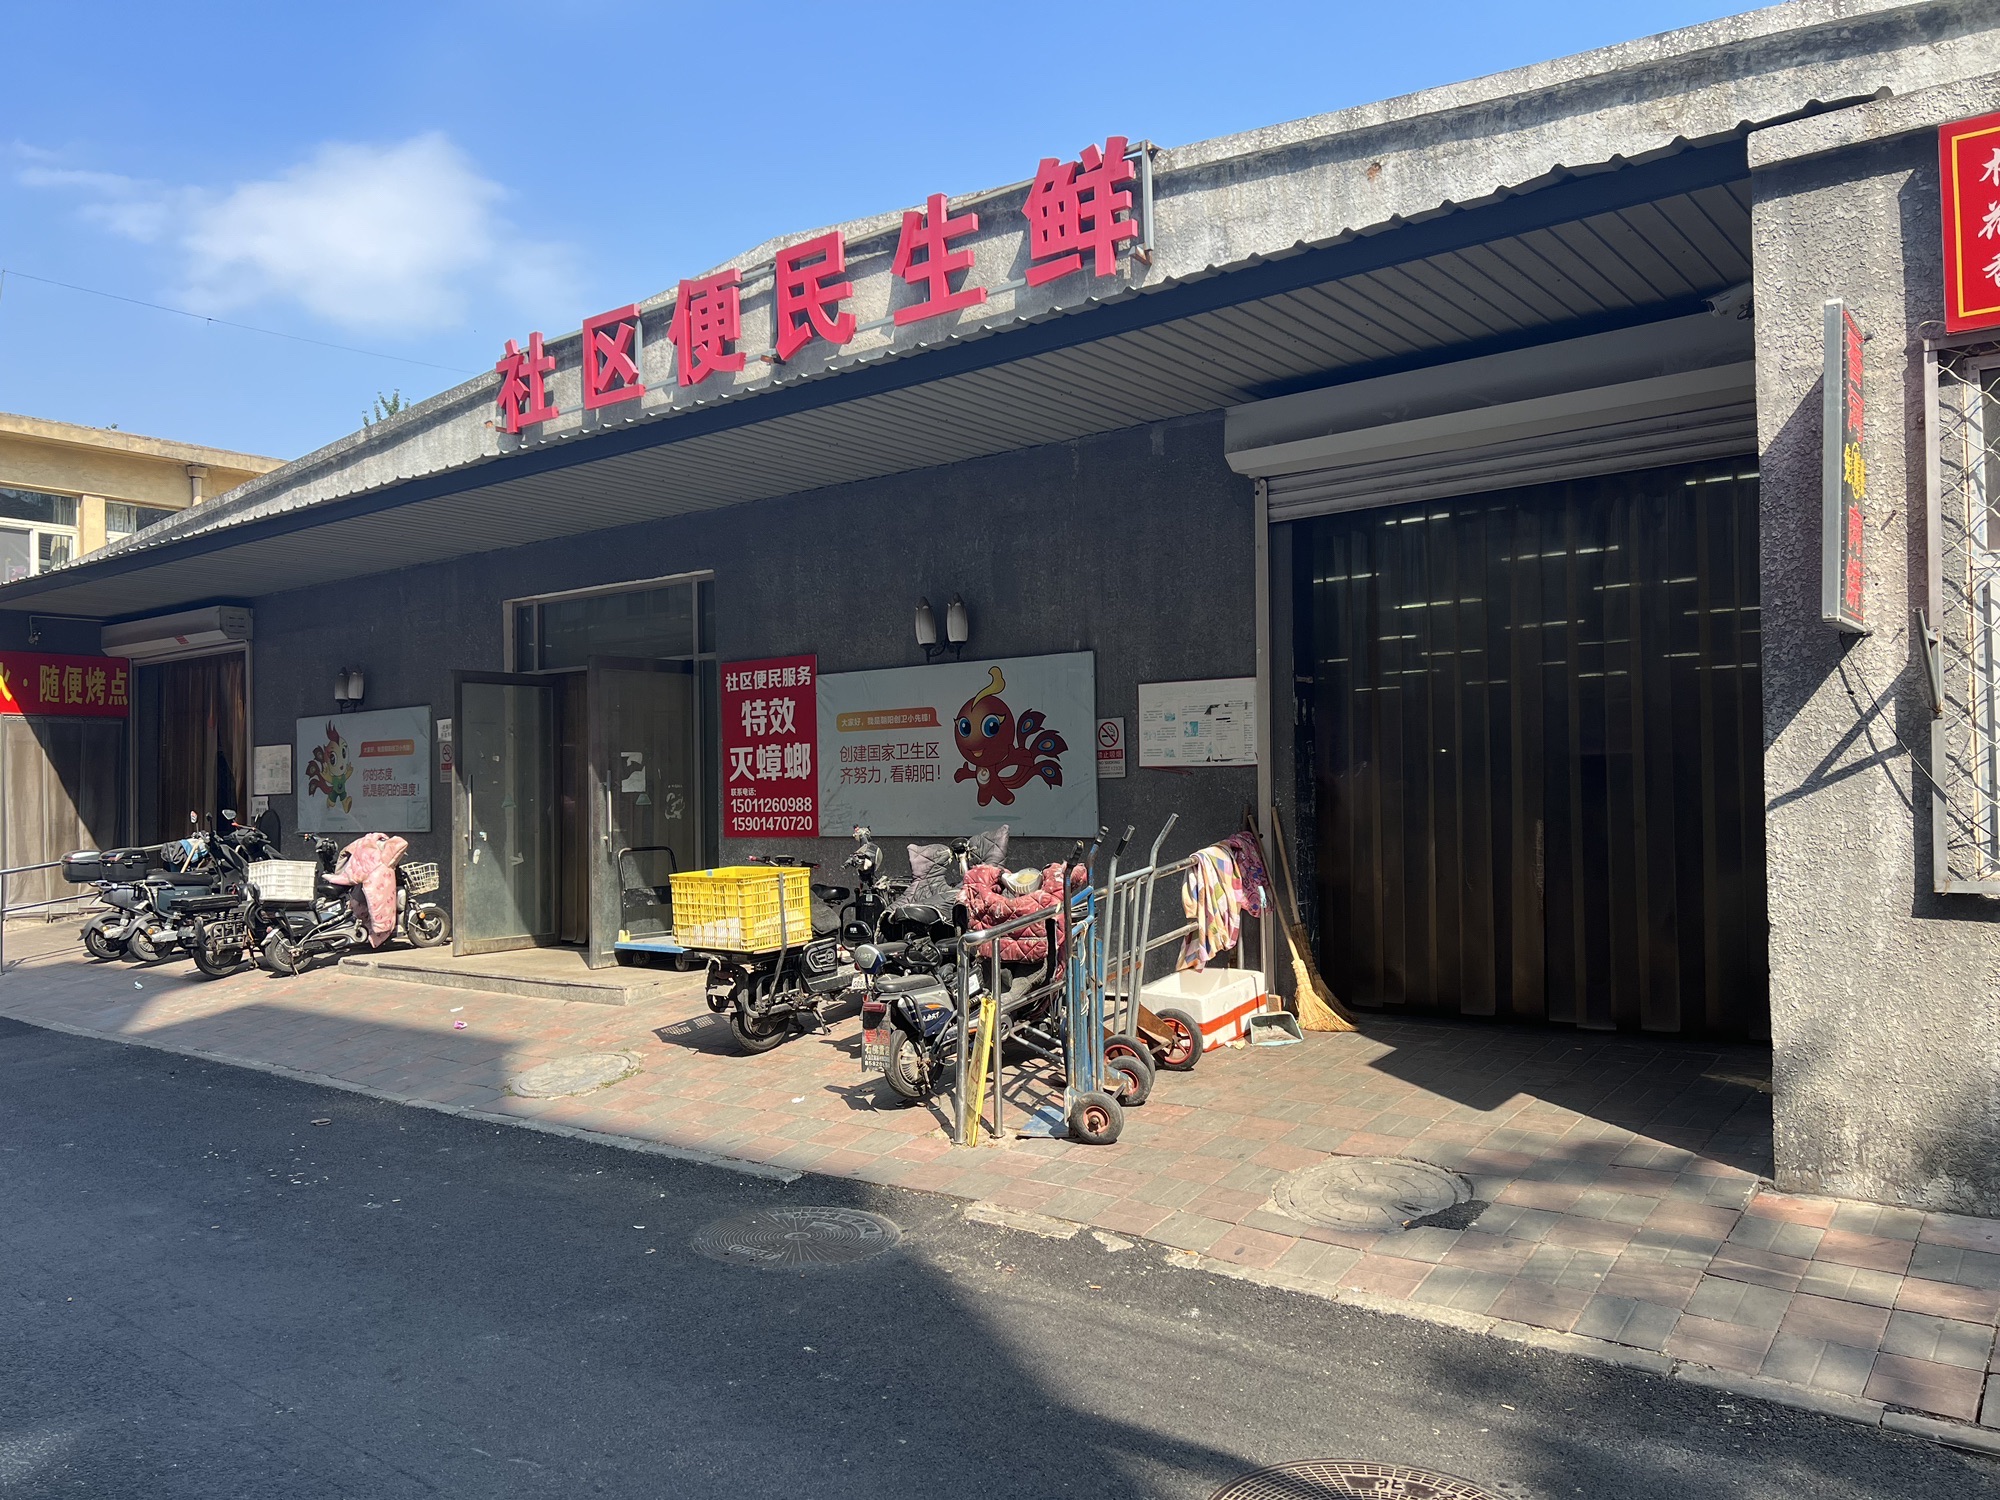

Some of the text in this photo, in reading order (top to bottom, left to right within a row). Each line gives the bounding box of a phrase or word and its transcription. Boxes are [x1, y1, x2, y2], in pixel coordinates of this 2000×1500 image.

[495, 136, 1138, 435] 社区便民生鲜
[725, 665, 812, 693] 社区便民服务
[741, 696, 796, 737] 特效
[729, 742, 811, 783] 灭蟑螂
[840, 741, 940, 763] 创建国家卫生区
[840, 764, 941, 785] 齐努力，看朝阳！
[731, 797, 812, 813] 15011260988
[732, 815, 812, 831] 15901470720
